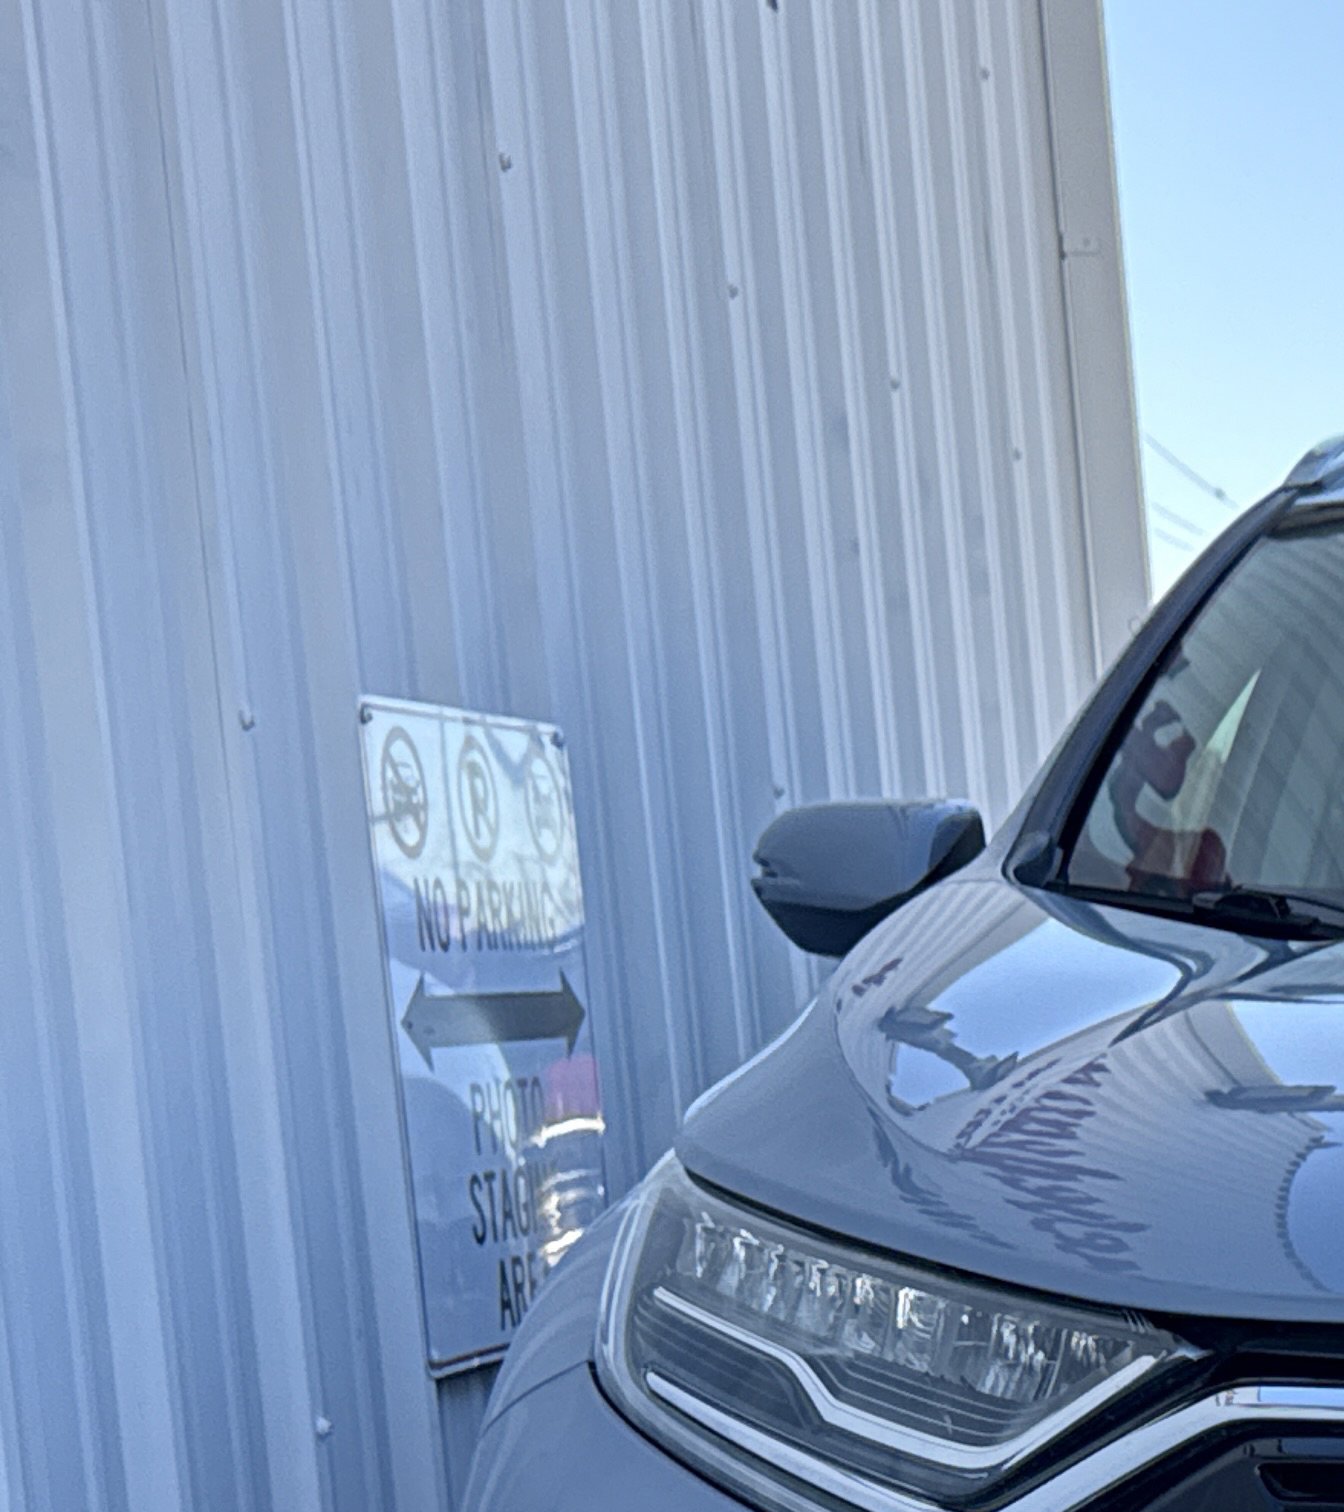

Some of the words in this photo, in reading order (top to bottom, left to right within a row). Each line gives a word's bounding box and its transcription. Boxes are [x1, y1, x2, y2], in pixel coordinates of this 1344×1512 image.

[414, 878, 450, 953] NO
[456, 879, 557, 952] PARKING
[469, 1076, 545, 1155] PHOTO
